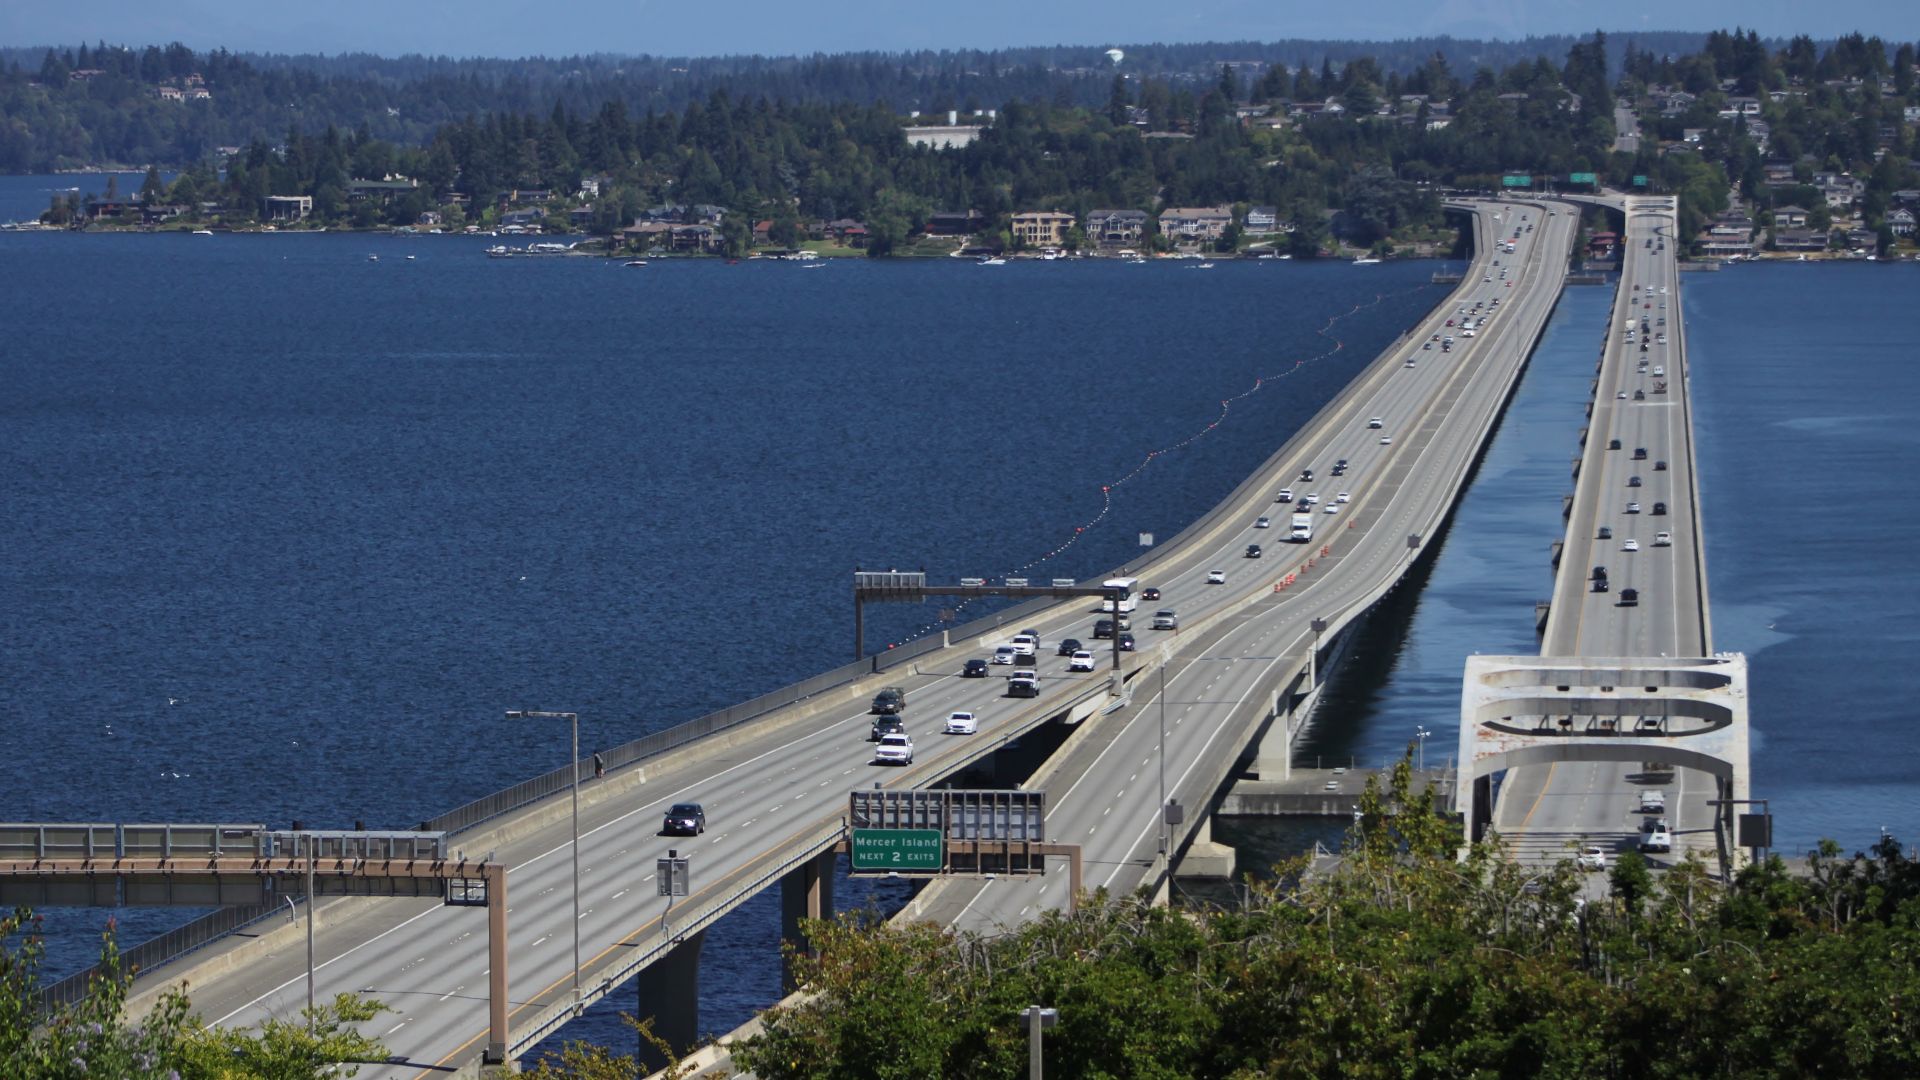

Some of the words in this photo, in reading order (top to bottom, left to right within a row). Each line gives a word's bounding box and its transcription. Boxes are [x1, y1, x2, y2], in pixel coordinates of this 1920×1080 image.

[856, 837, 896, 846] Mercer
[902, 838, 938, 847] Island
[892, 852, 901, 862] 2
[907, 853, 935, 861] EXITS
